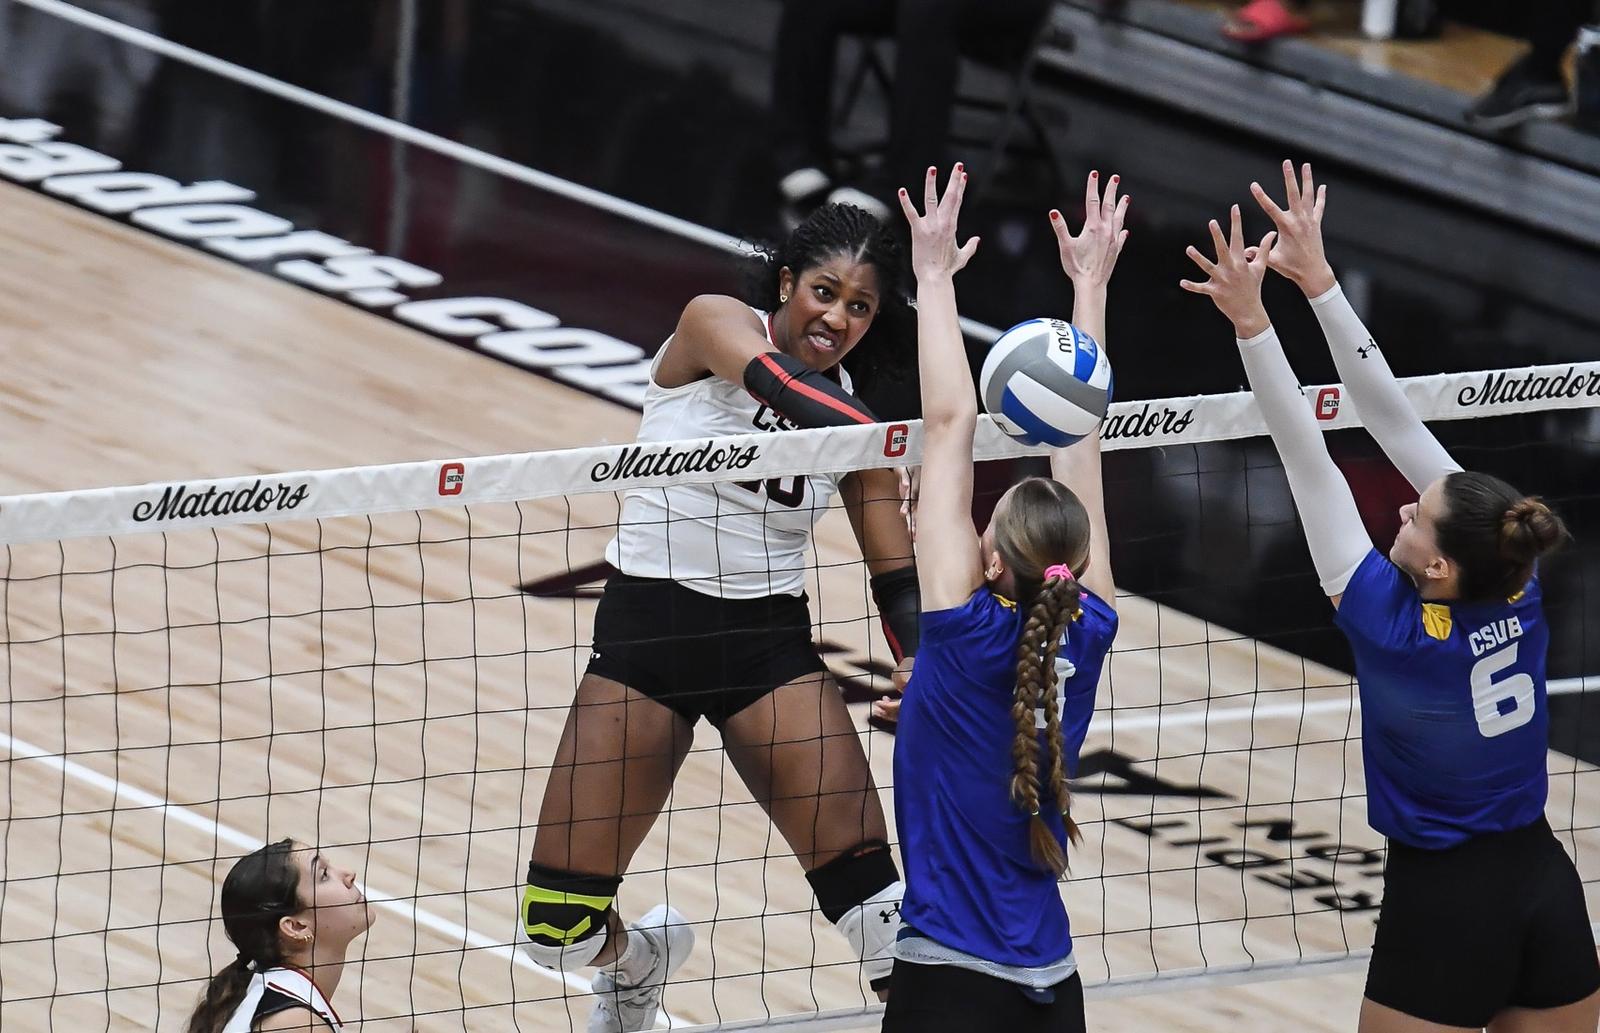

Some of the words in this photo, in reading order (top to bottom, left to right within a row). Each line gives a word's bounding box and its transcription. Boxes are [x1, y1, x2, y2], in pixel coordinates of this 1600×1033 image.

[1457, 366, 1600, 406] Matador
[590, 440, 761, 483] Matadors
[132, 479, 310, 522] Matadors
[1468, 615, 1524, 657] CSUB
[1470, 641, 1536, 738] 6
